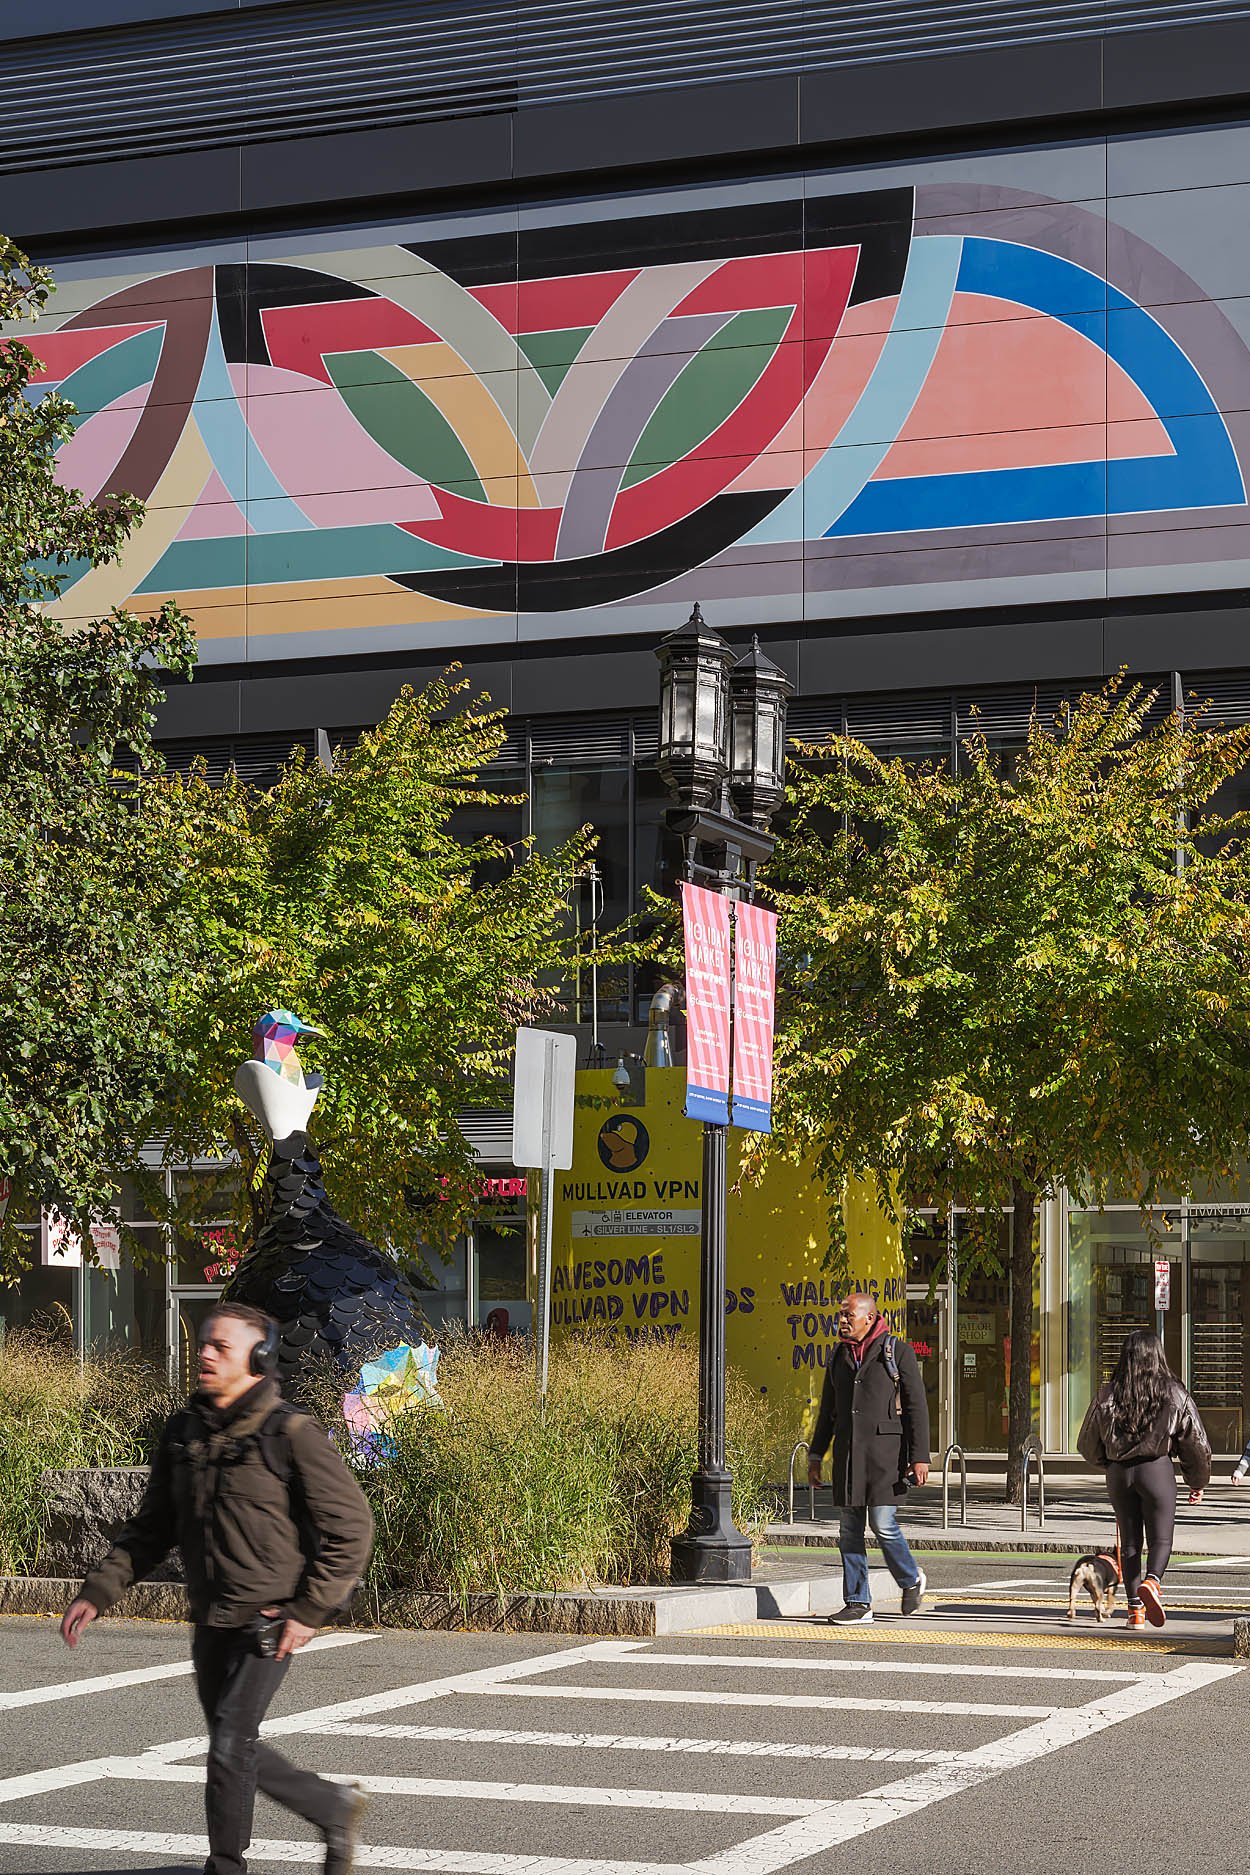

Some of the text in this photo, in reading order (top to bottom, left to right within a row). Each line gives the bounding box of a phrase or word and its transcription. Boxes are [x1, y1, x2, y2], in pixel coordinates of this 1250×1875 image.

[687, 920, 726, 949] HOLIDAY
[691, 942, 724, 969] MARKET
[738, 937, 773, 964] HOLIDAY
[740, 958, 770, 984] MARKET
[562, 1180, 699, 1202] MULLVAD VPN
[625, 1211, 673, 1220] ELEVATOR
[596, 1225, 625, 1234] SILVER
[627, 1225, 648, 1233] LINE
[656, 1225, 695, 1233] SL1/SL2
[552, 1255, 665, 1293] AWESOME
[632, 1289, 690, 1319] VPN
[724, 1286, 755, 1315] DS
[786, 1311, 841, 1340] TOW
[959, 1331, 988, 1340] SHOP
